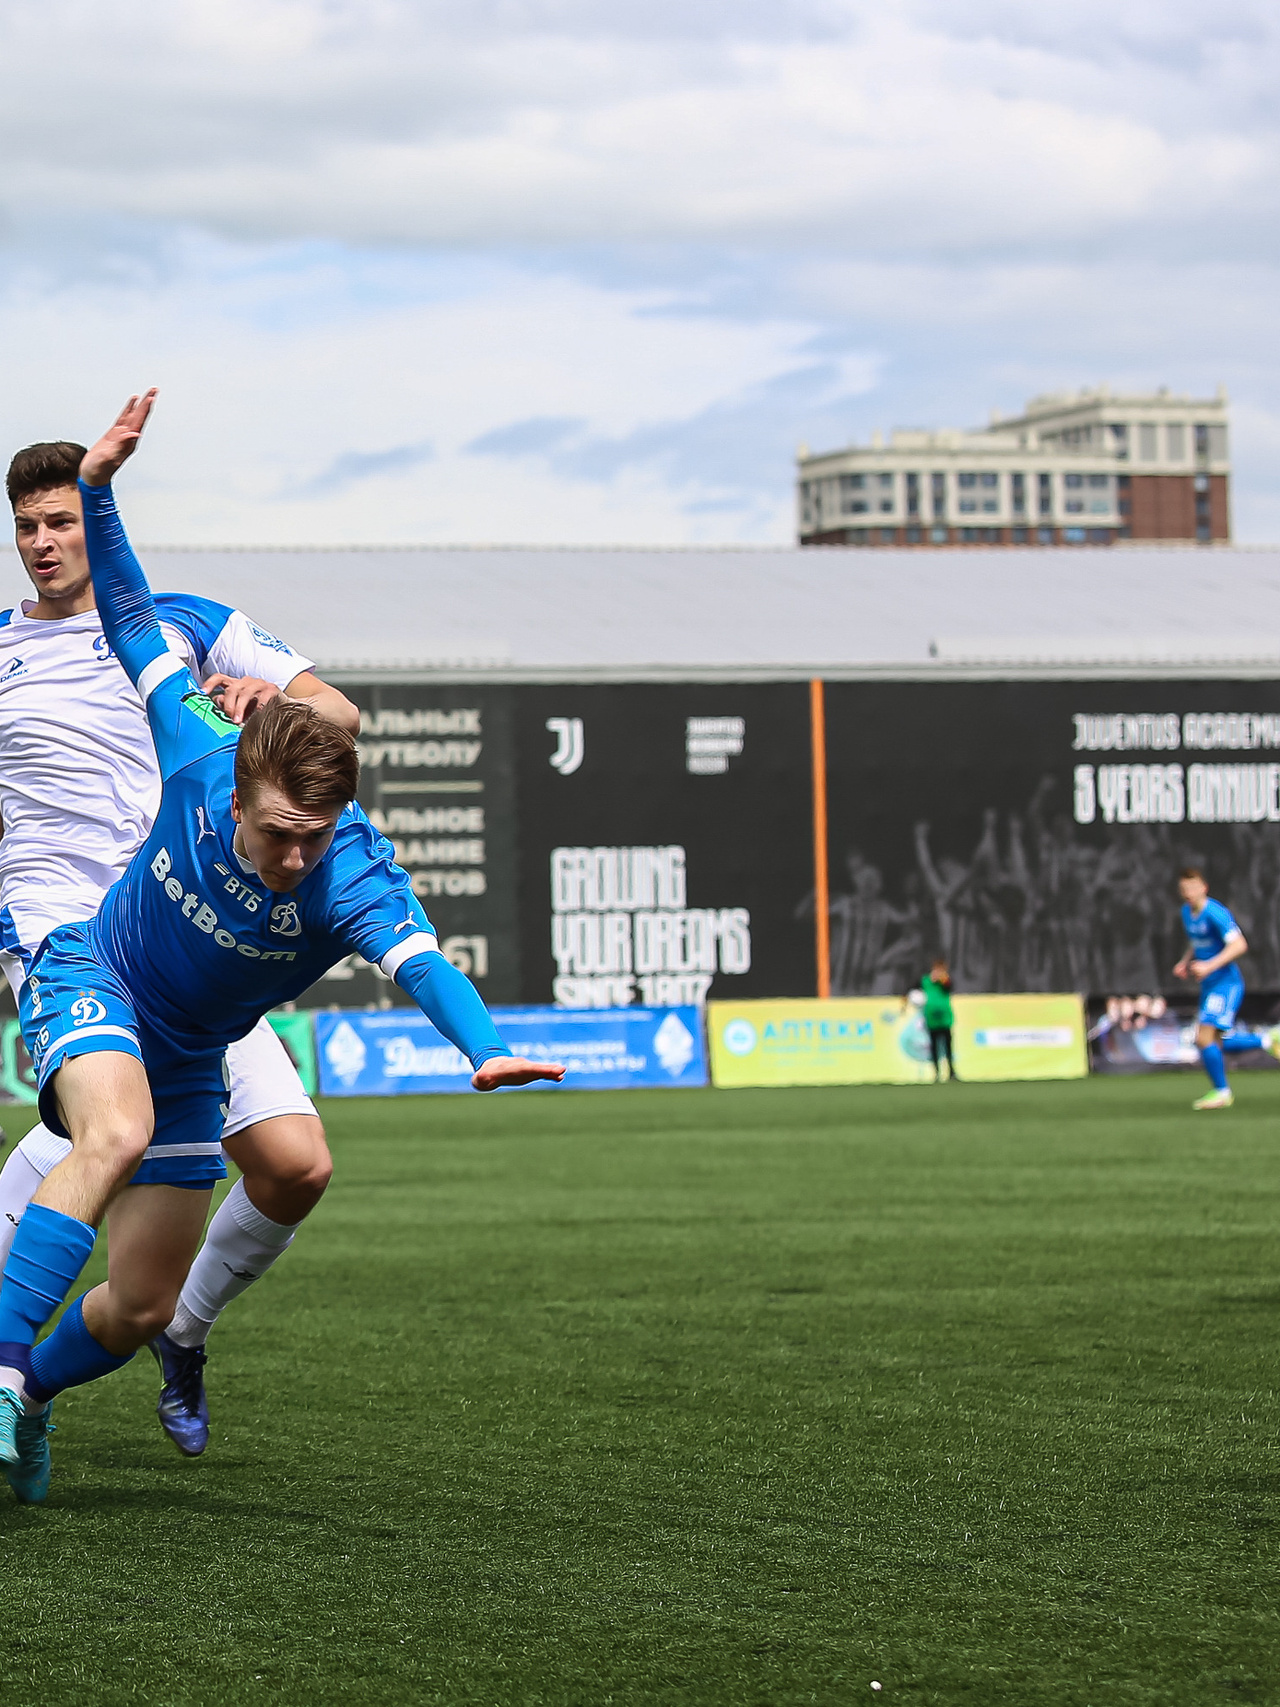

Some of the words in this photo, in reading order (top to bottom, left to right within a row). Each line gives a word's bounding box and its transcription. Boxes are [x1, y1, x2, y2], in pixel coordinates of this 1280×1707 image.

[0, 667, 30, 684] DEMIX
[1071, 712, 1180, 751] JUVENTUS
[1097, 762, 1185, 824] YEARS
[150, 846, 297, 962] BetBoom
[550, 845, 687, 912] GROWING
[551, 911, 633, 975] YOUR
[633, 907, 752, 975] DREAMS
[763, 1019, 873, 1041] АПТЕКИ
